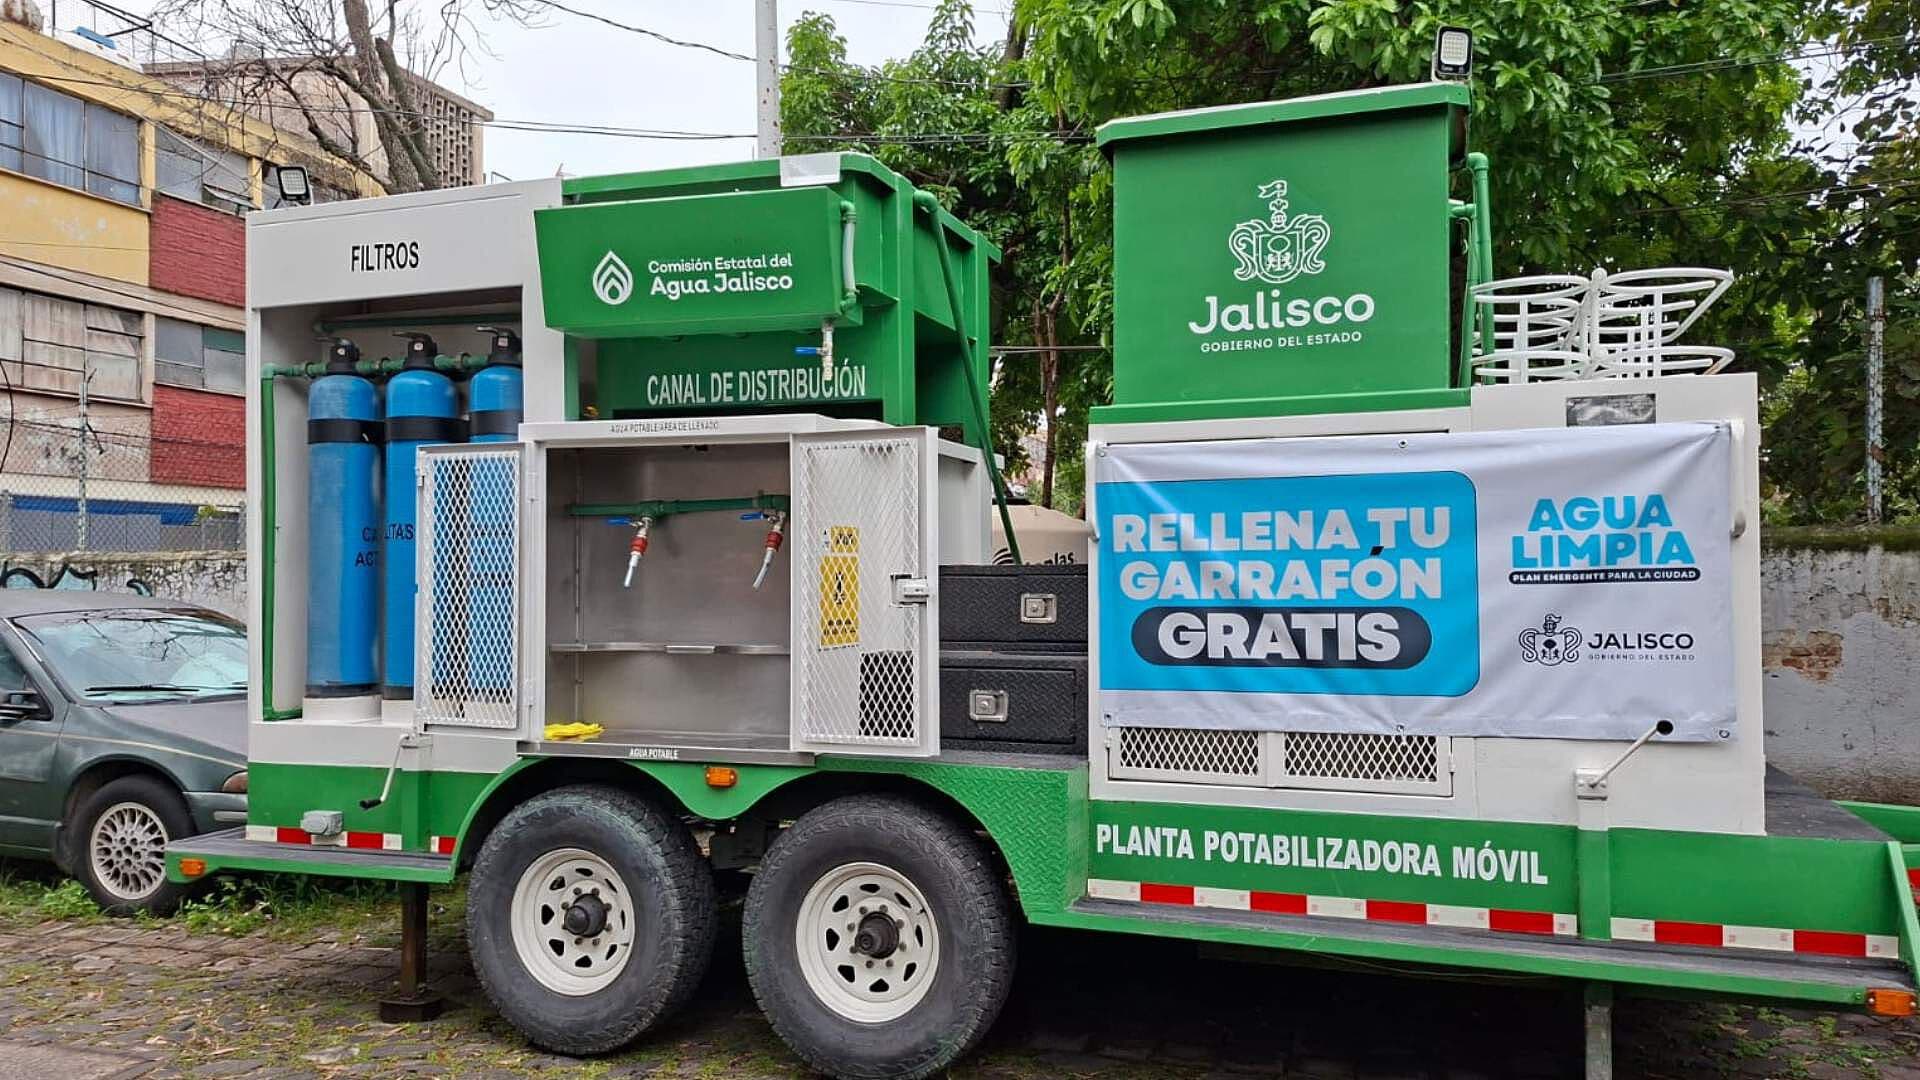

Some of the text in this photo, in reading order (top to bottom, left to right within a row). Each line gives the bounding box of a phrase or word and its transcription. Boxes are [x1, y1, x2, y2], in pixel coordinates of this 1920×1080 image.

[351, 241, 419, 272] FILTROS
[648, 252, 793, 273] Comisión Estatal del
[650, 271, 793, 300] Agua Jalisco
[1188, 289, 1375, 334] Jalisco
[1200, 331, 1362, 353] GOBIERNO DEL ESTADO
[647, 358, 866, 406] CANAL DE DISTRIBUCIÓN
[1112, 506, 1451, 553] RELLENA TU
[1527, 494, 1673, 532] AGUA
[1512, 531, 1696, 569] LIMPIA
[1119, 546, 1442, 601] GARRAFÓN
[1512, 569, 1697, 583] PLAN EMERGENTE PARA LA CIUDAD
[1158, 612, 1401, 662] GRATIS
[1588, 633, 1694, 650] JALISCO
[1588, 653, 1635, 662] GOBIERNO
[1658, 654, 1695, 662] ESTADO
[1096, 824, 1549, 885] PLANTA POTABILIZADORA MÓVIL
